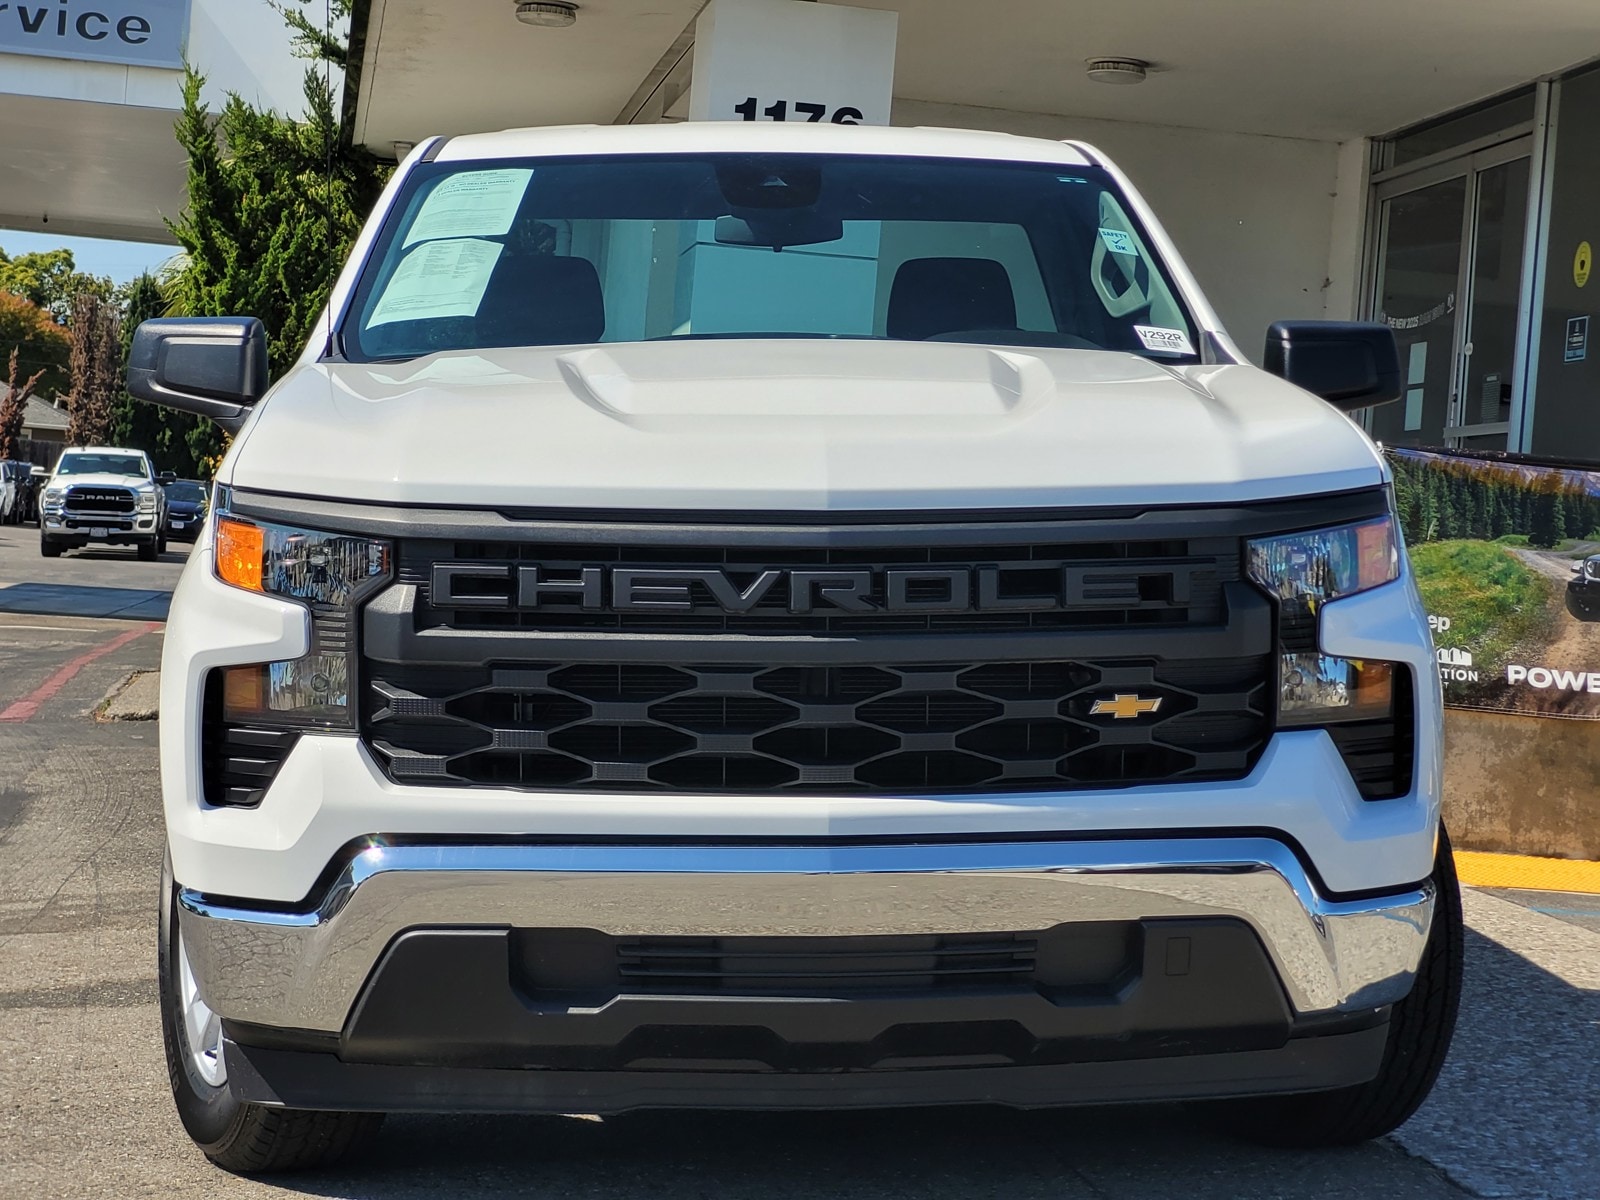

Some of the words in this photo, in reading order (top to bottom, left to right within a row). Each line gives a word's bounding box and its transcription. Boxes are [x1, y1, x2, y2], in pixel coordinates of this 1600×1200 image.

[1101, 230, 1127, 239] SAFETY
[1138, 329, 1184, 342] V292R
[430, 557, 1216, 614] CHEVROLET
[1440, 668, 1478, 682] TION
[1507, 664, 1600, 693] POWE
